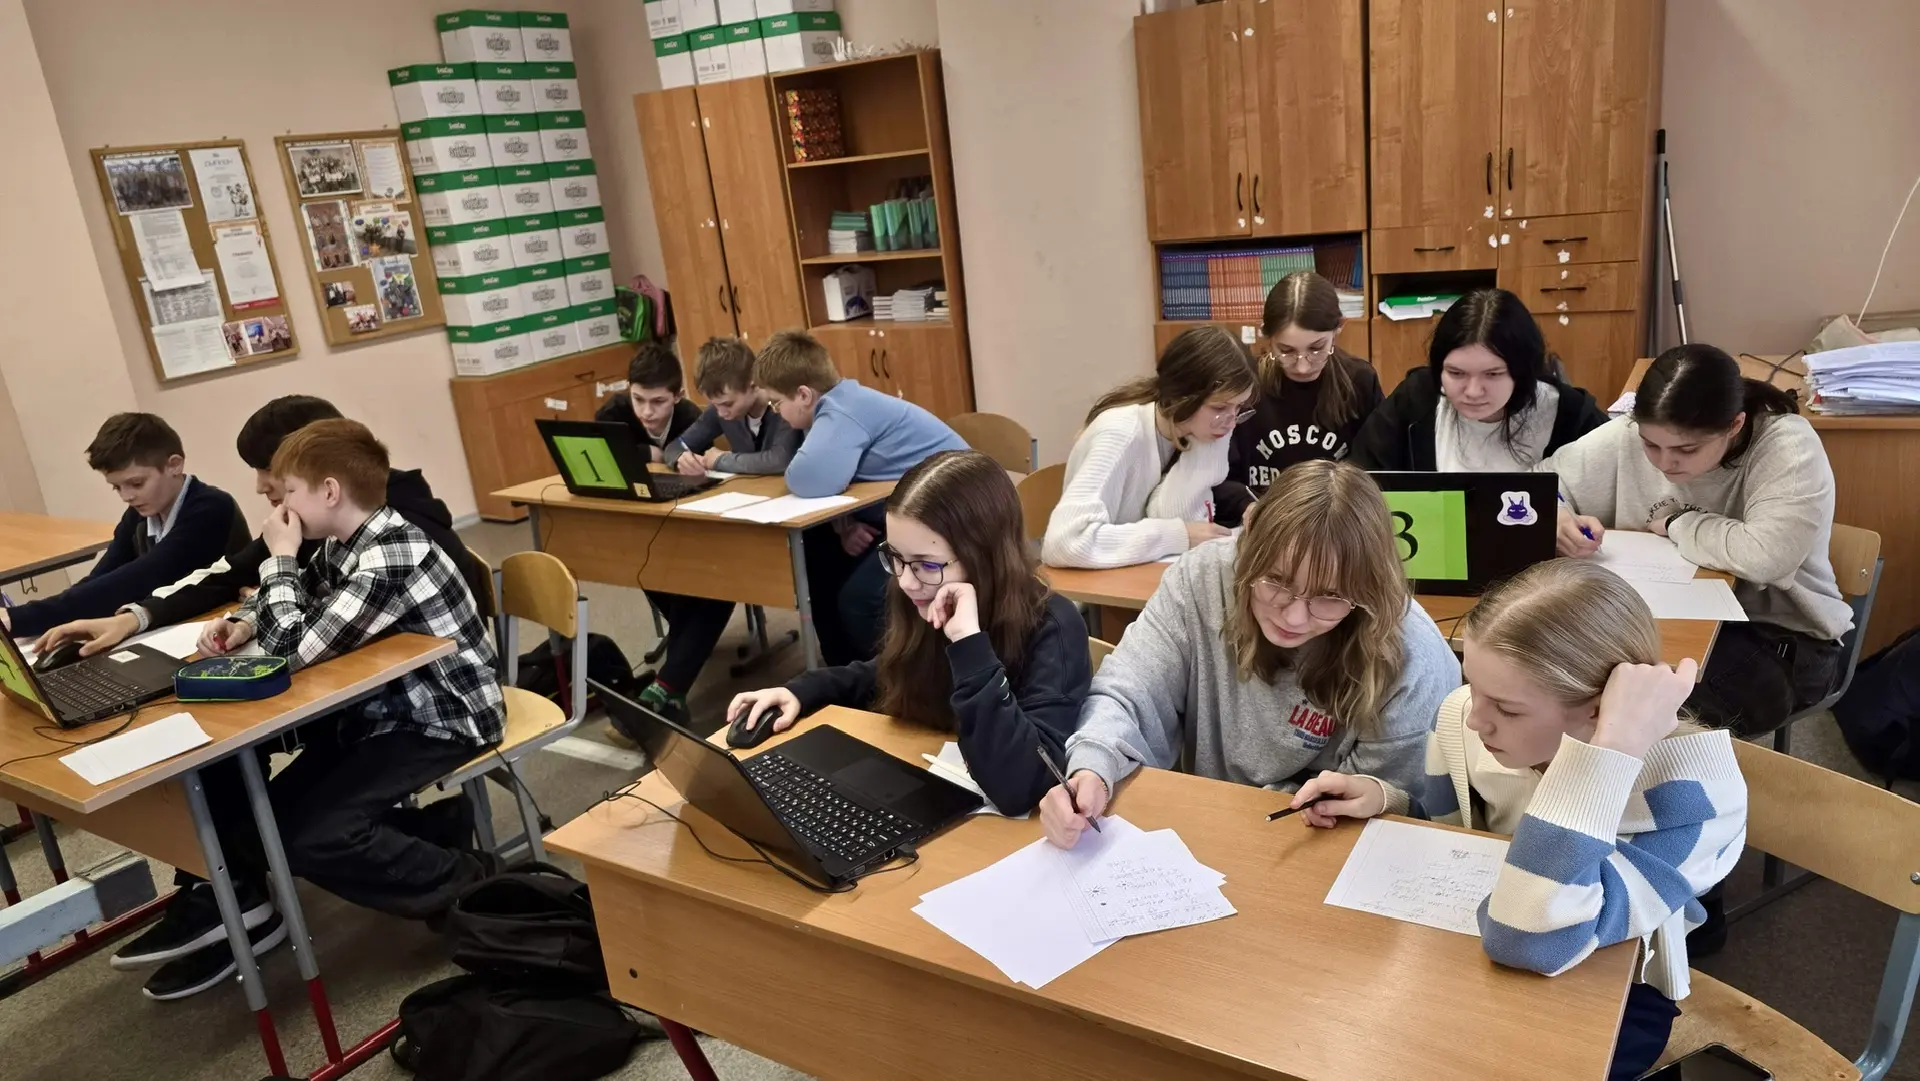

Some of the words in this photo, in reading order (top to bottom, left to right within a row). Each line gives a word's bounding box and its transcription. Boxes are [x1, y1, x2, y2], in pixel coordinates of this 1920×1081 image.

[580, 449, 604, 482] 1
[1391, 510, 1419, 562] 3
[1287, 703, 1310, 729] LA
